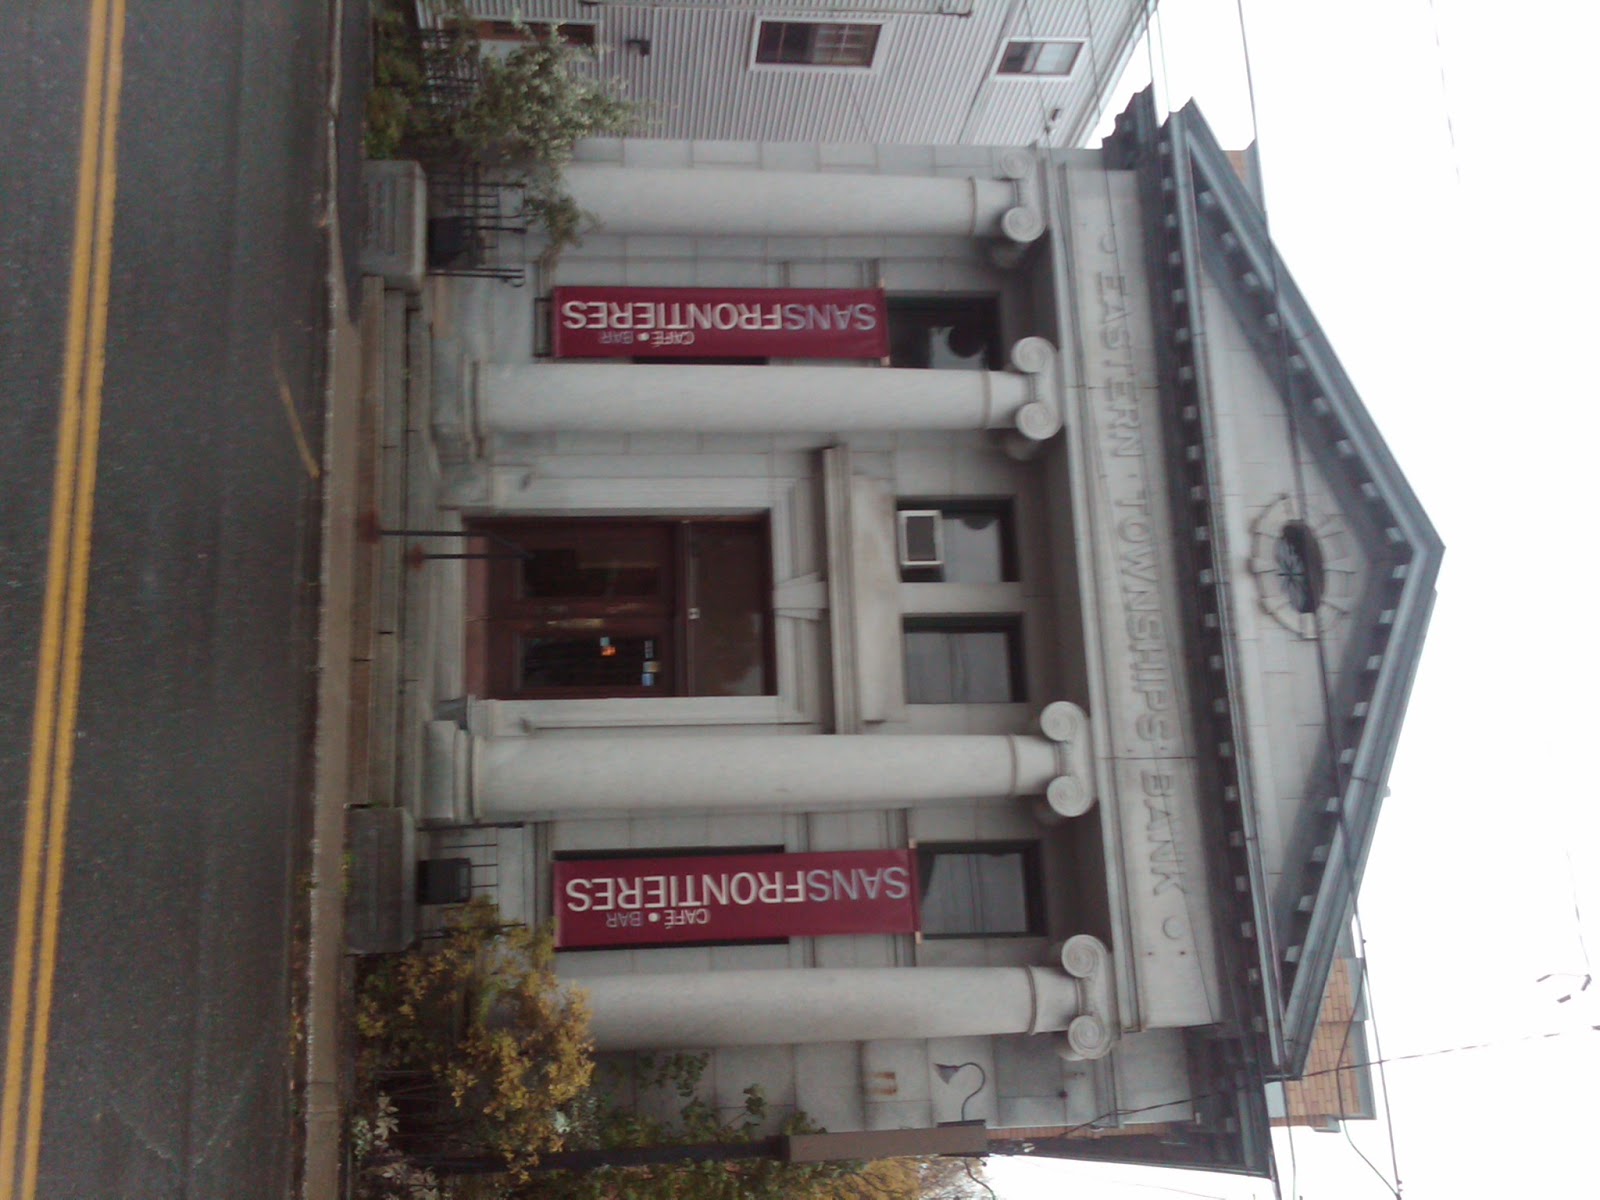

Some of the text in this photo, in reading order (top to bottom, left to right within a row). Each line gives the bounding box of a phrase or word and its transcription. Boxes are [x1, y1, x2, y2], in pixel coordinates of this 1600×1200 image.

[600, 331, 695, 347] CAFÉ BAR
[1096, 271, 1190, 897] EASTERN TOWNSHIPS BANK
[606, 908, 710, 930] CAFÉ BAR
